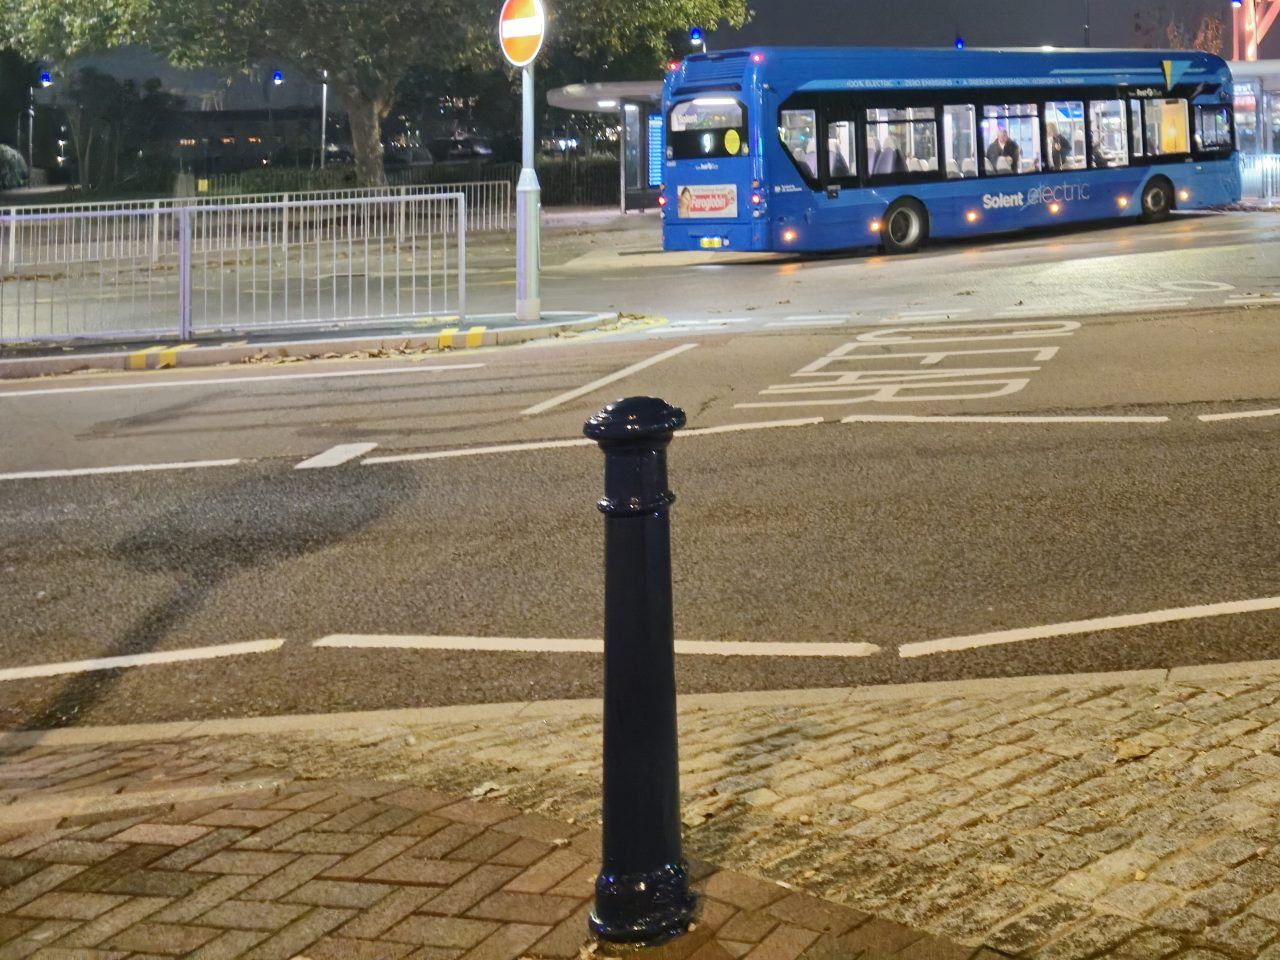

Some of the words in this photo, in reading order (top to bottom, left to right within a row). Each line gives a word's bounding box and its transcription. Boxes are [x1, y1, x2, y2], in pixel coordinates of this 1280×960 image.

[703, 134, 712, 153] 9
[982, 192, 1024, 209] Solent
[1027, 181, 1091, 205] electric
[734, 321, 1082, 409] CLEAR
